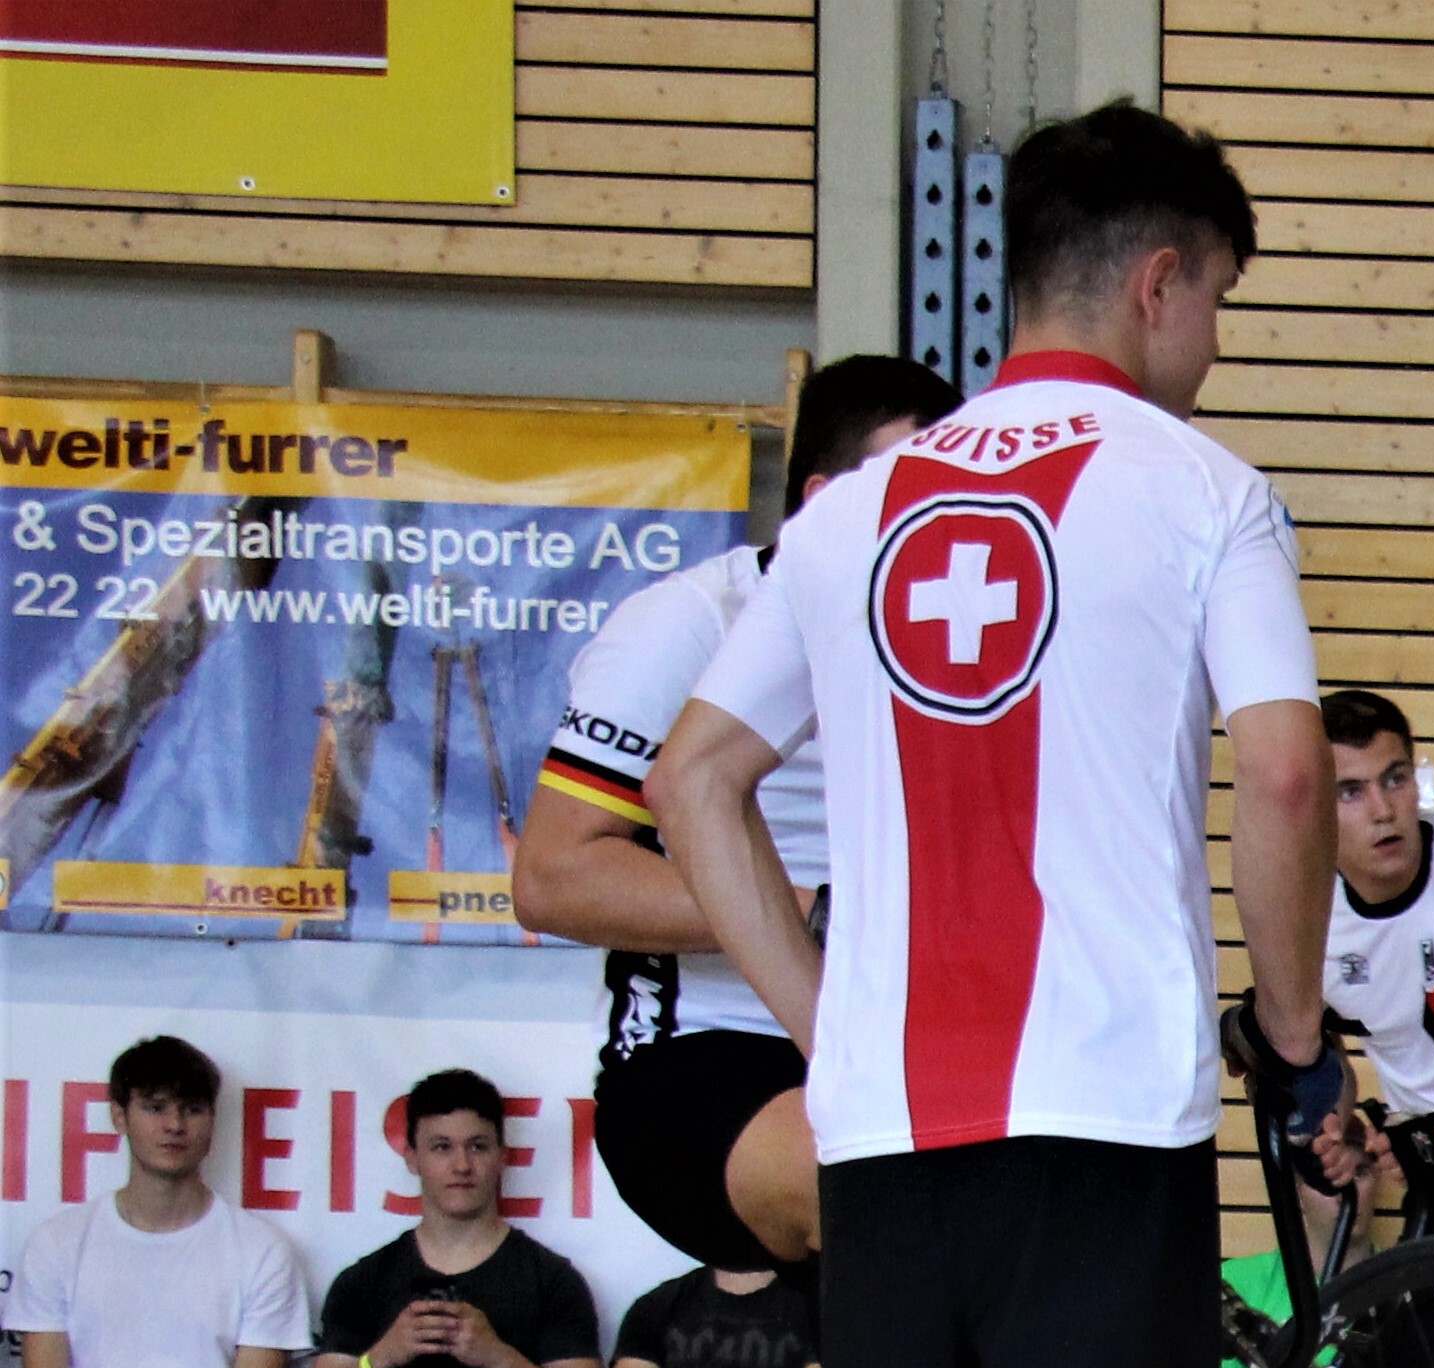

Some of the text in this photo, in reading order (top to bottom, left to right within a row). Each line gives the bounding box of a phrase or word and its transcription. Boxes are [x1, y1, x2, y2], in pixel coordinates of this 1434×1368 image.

[0, 418, 408, 478] welti-furrer
[911, 412, 1101, 462] SUISSE
[12, 501, 682, 577] & Spezialtransporte AG
[13, 572, 79, 619] 22
[97, 577, 160, 621] 22
[205, 877, 337, 908] knecht
